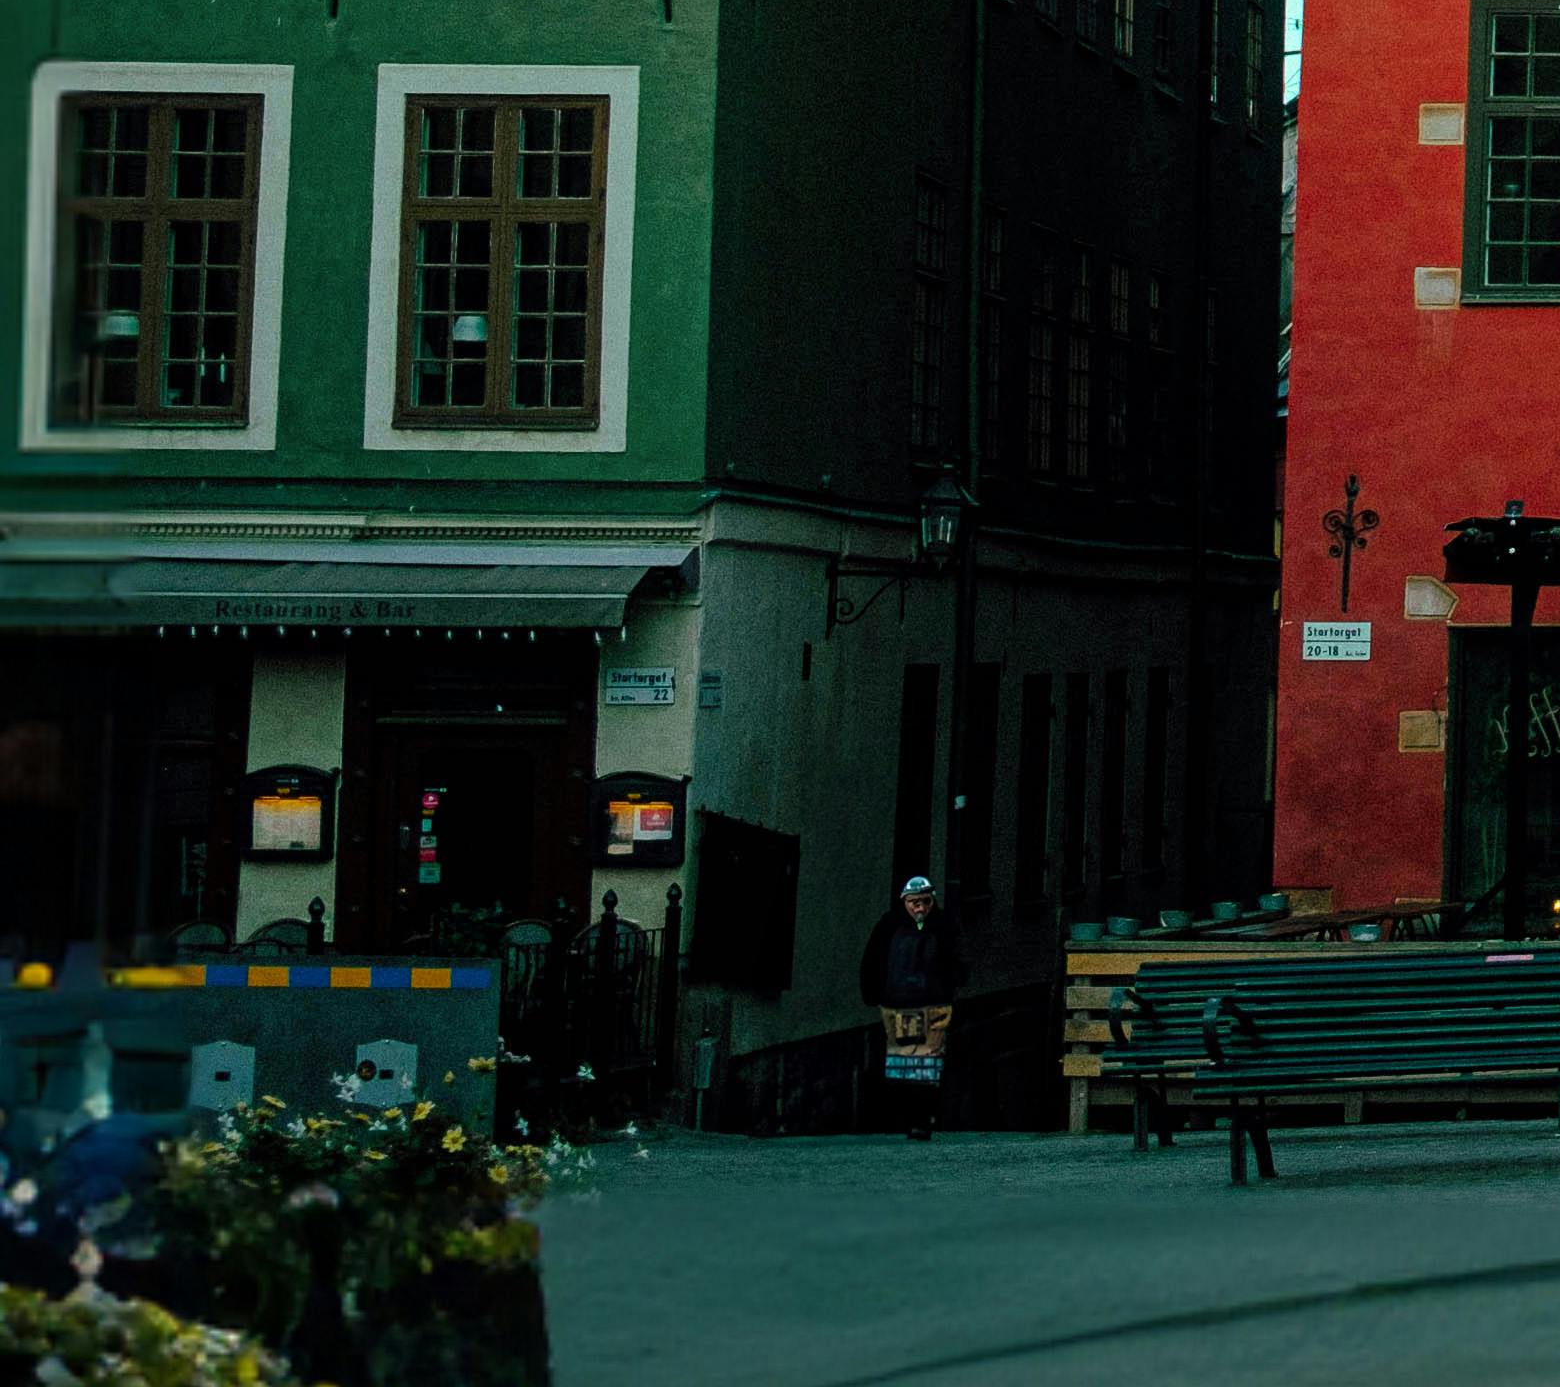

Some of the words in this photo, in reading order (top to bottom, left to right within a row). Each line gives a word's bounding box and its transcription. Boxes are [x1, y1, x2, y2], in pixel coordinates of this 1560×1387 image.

[215, 600, 342, 622] Restaurang
[349, 600, 367, 619] &
[376, 600, 415, 618] Bar
[1307, 626, 1362, 640] Stortorget
[1307, 645, 1339, 657] 20-18
[611, 671, 667, 686] Stortorget
[653, 689, 669, 701] 22
